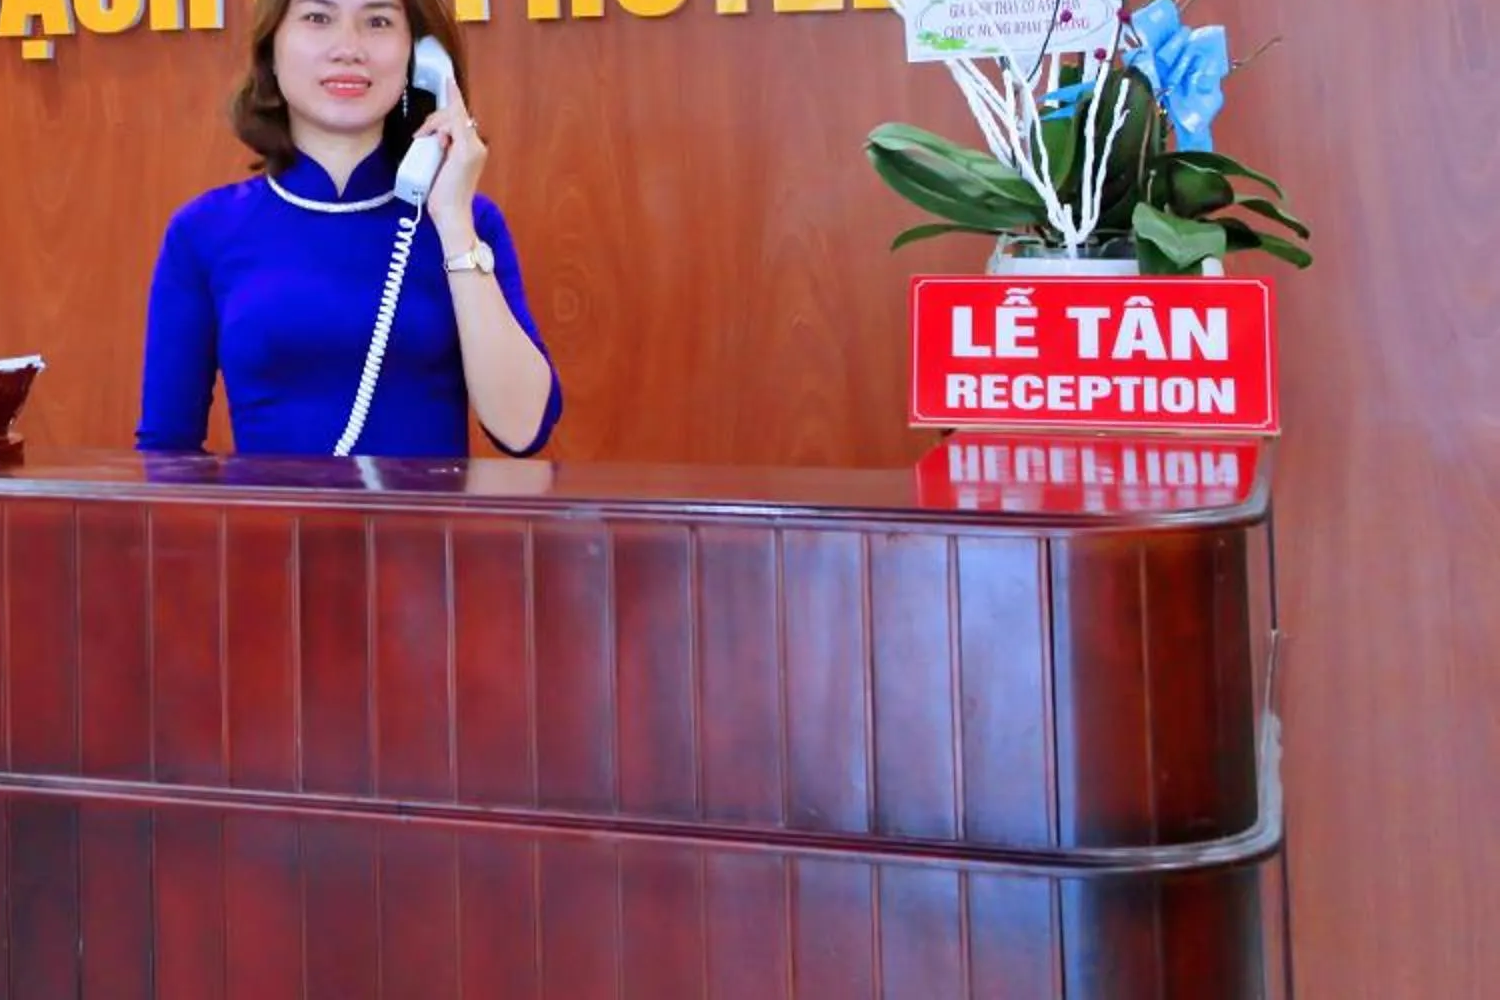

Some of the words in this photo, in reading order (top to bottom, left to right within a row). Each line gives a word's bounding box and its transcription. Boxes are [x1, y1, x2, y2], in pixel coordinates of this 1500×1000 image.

[951, 287, 1039, 358] LỄ
[1066, 295, 1229, 361] TÂN
[945, 373, 1236, 414] RECEPTION
